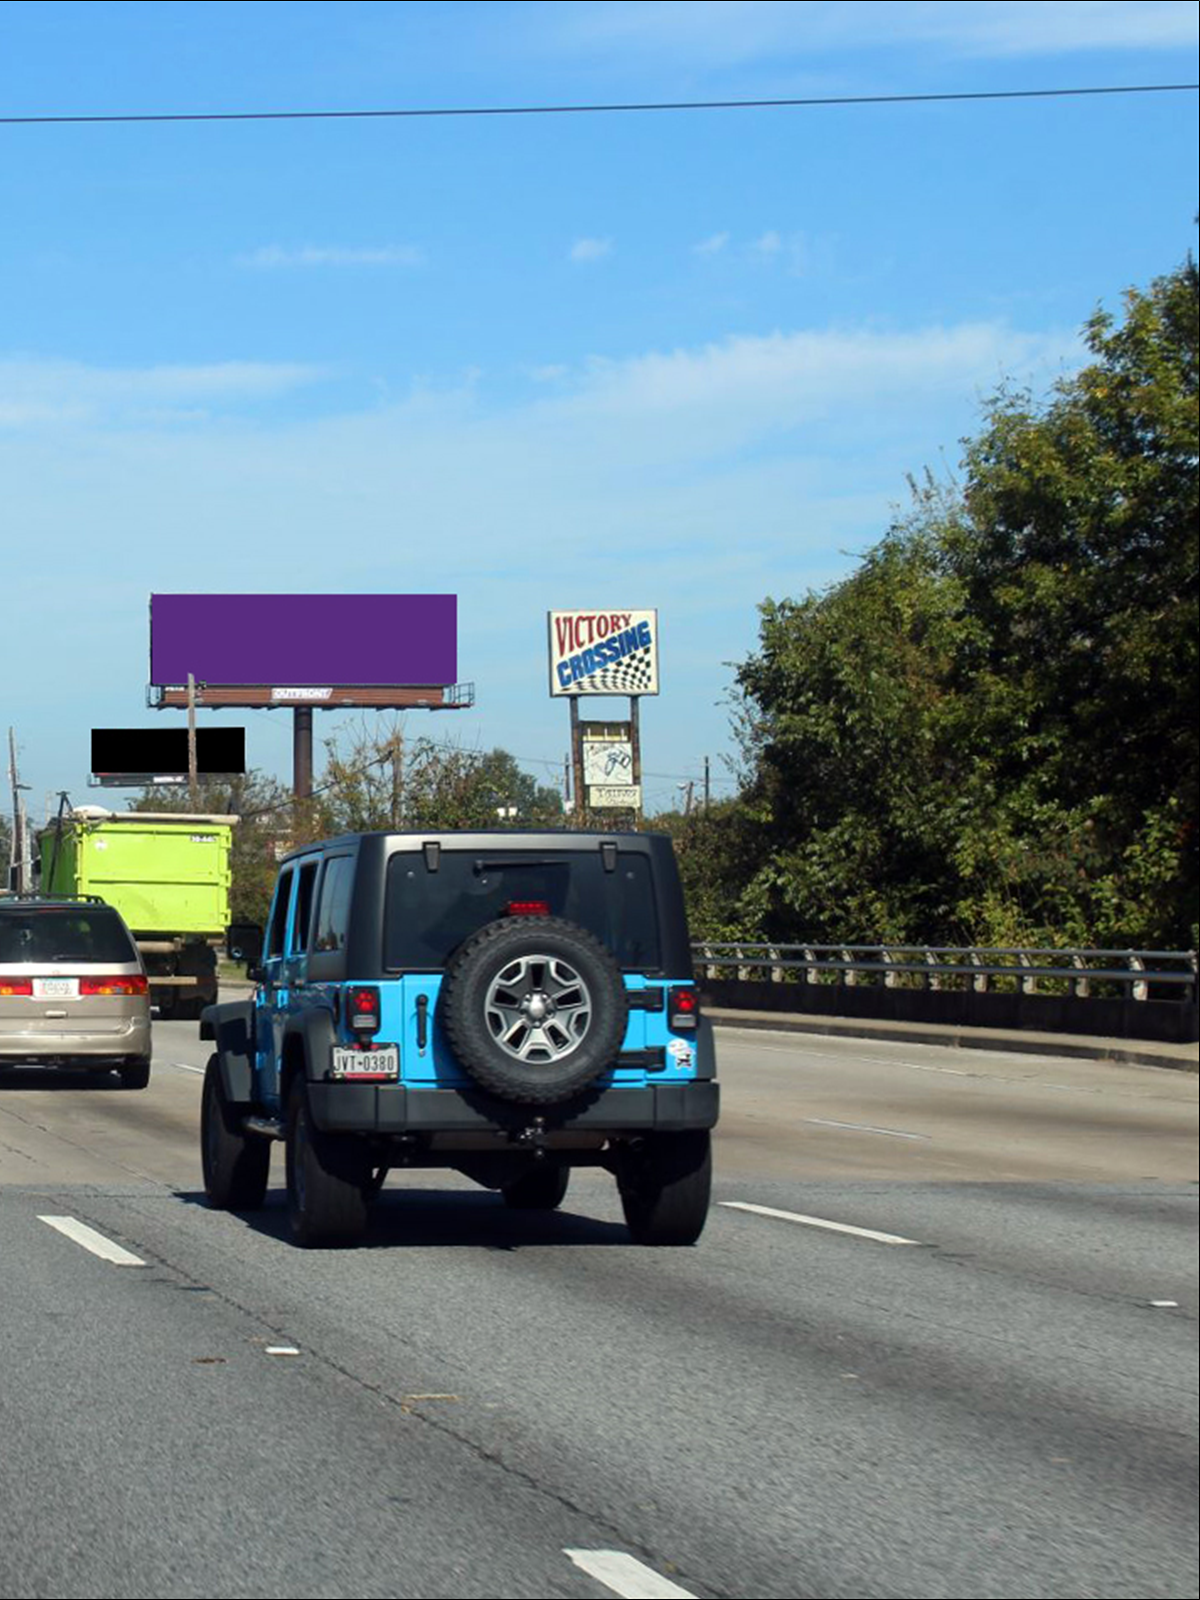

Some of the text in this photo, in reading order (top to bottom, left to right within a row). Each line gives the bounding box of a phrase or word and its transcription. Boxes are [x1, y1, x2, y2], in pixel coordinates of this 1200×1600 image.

[555, 613, 632, 658] VICTORY
[556, 620, 652, 688] CROSSING
[334, 1055, 394, 1071] JVT-0380
